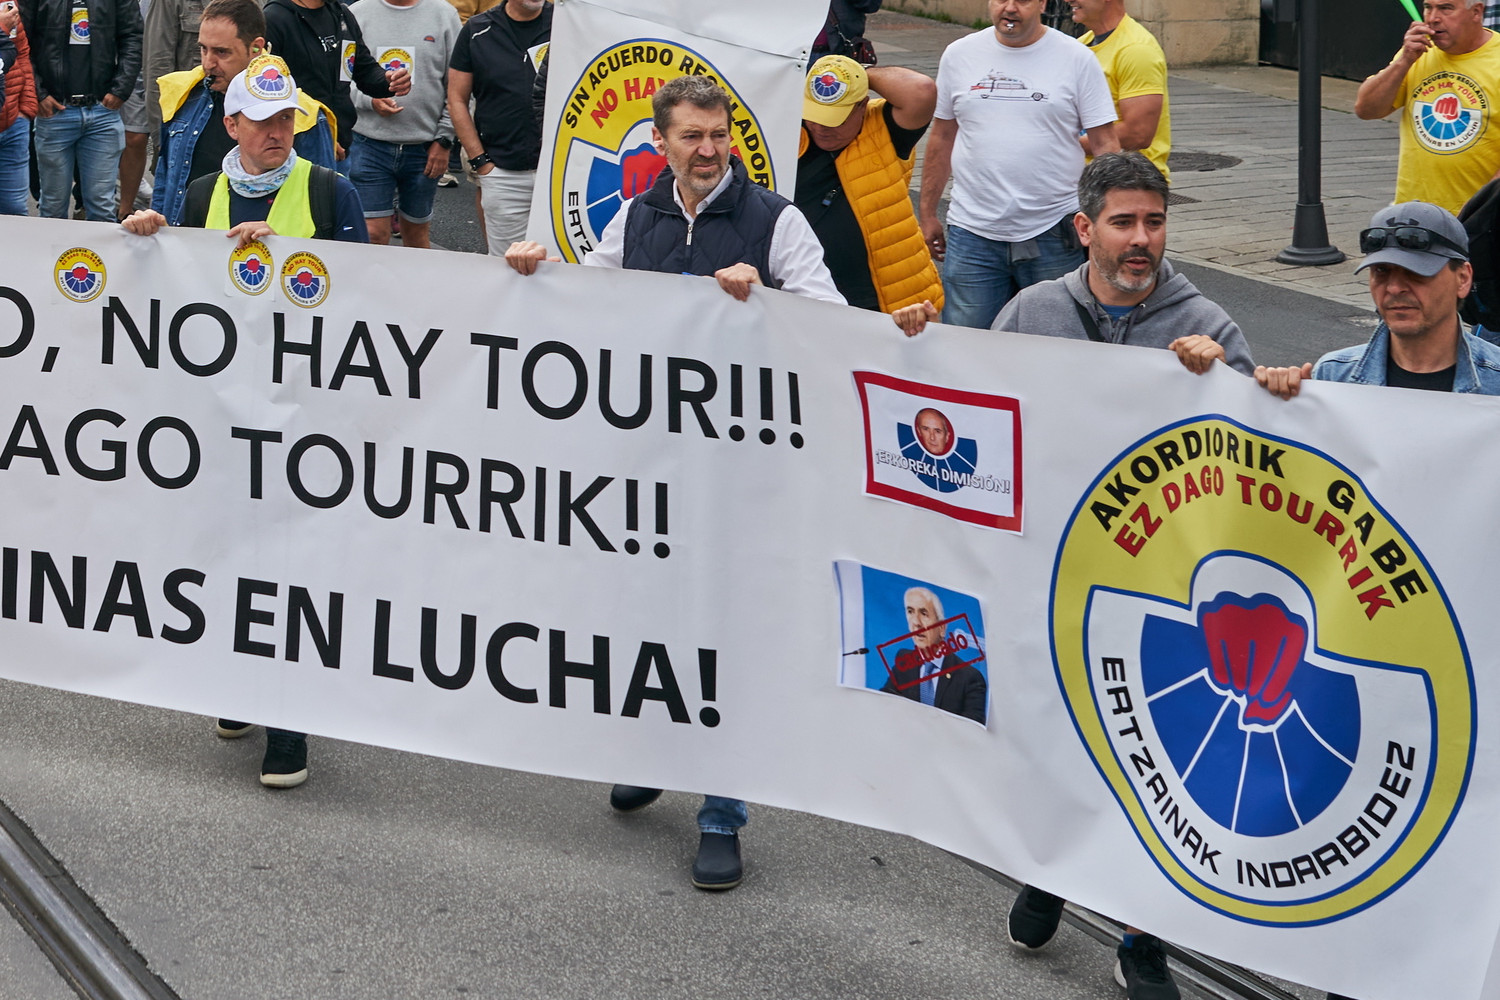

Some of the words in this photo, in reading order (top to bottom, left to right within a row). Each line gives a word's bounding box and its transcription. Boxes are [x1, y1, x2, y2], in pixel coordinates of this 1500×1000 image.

[565, 86, 590, 129] SIN
[589, 45, 674, 91] ACUERDO
[590, 88, 618, 129] NO
[624, 77, 665, 101] HA
[1422, 86, 1436, 96] NO
[1457, 85, 1478, 105] TOUR
[1456, 75, 1487, 109] REGULADOR
[1415, 115, 1443, 147] ERTZAINAS
[1458, 121, 1479, 144] LUCHA
[100, 295, 238, 377] NO
[271, 311, 444, 400] HAY
[469, 331, 805, 450] TOUR!!!
[230, 426, 671, 560] TOURRIK!!
[876, 449, 940, 479] ¡ERKOREKA
[941, 470, 1011, 494] DIMISIÓN!
[1089, 427, 1287, 532] AKORDIORIK
[1327, 479, 1429, 604] GABE
[1113, 501, 1164, 558] EZ
[1161, 465, 1224, 513] DAGO
[1235, 473, 1396, 622] TOURRIK
[233, 577, 345, 670] EN
[371, 598, 721, 729] LUCHA!
[895, 632, 969, 672] caducado
[1101, 656, 1222, 876] ERTZAINAK
[1236, 740, 1416, 889] INDARBIDEZ
